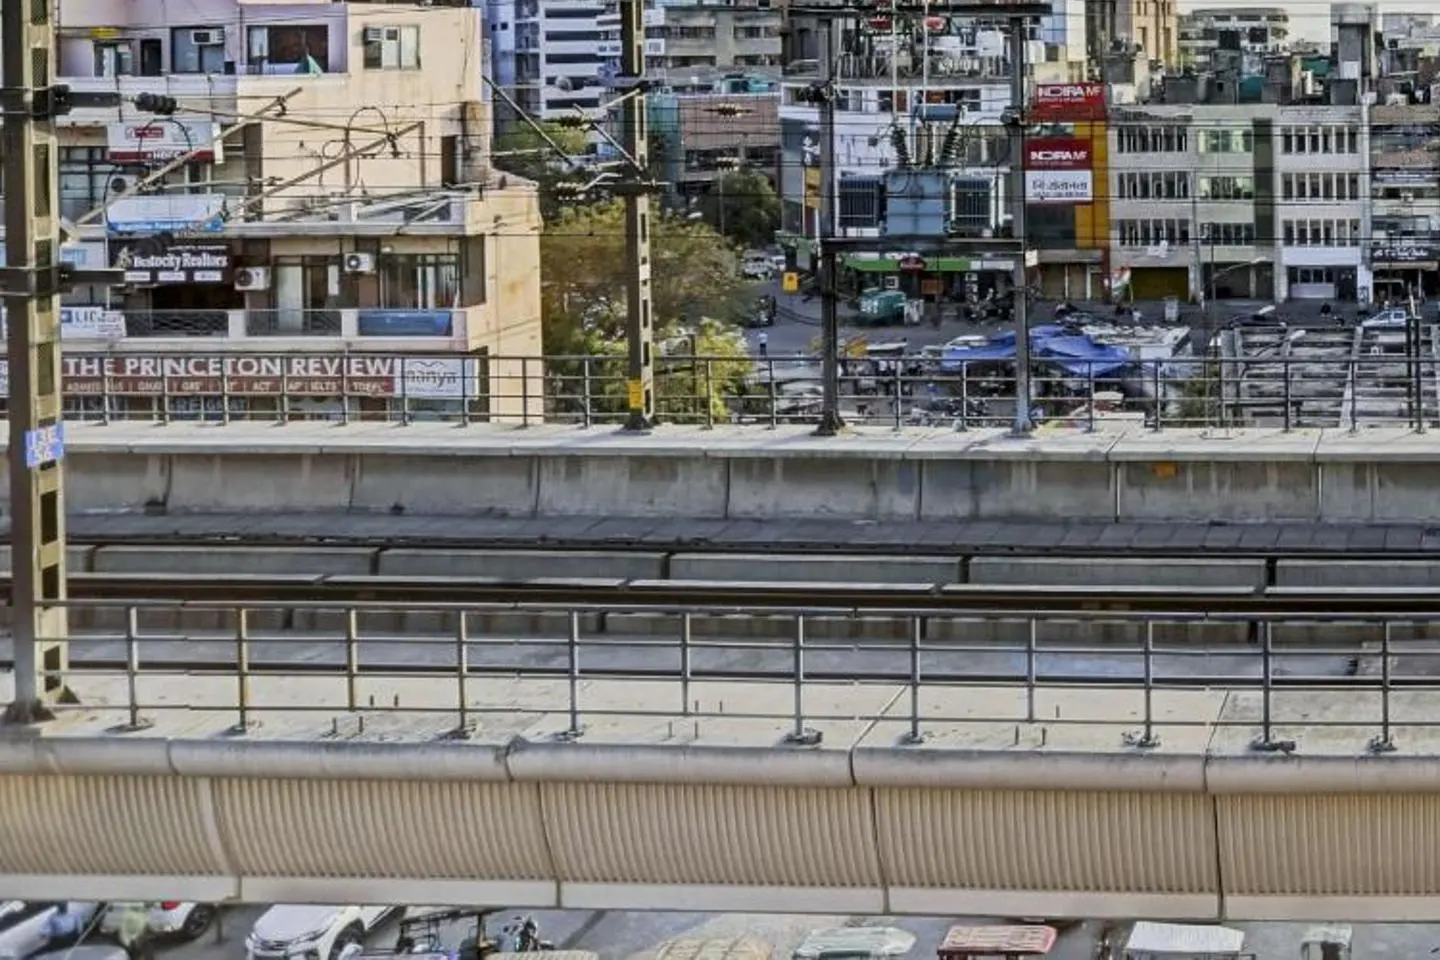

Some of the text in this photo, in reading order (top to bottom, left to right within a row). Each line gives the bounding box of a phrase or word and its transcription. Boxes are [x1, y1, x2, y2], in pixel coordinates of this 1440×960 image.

[64, 357, 393, 377] THE PRINCETON REVIEW
